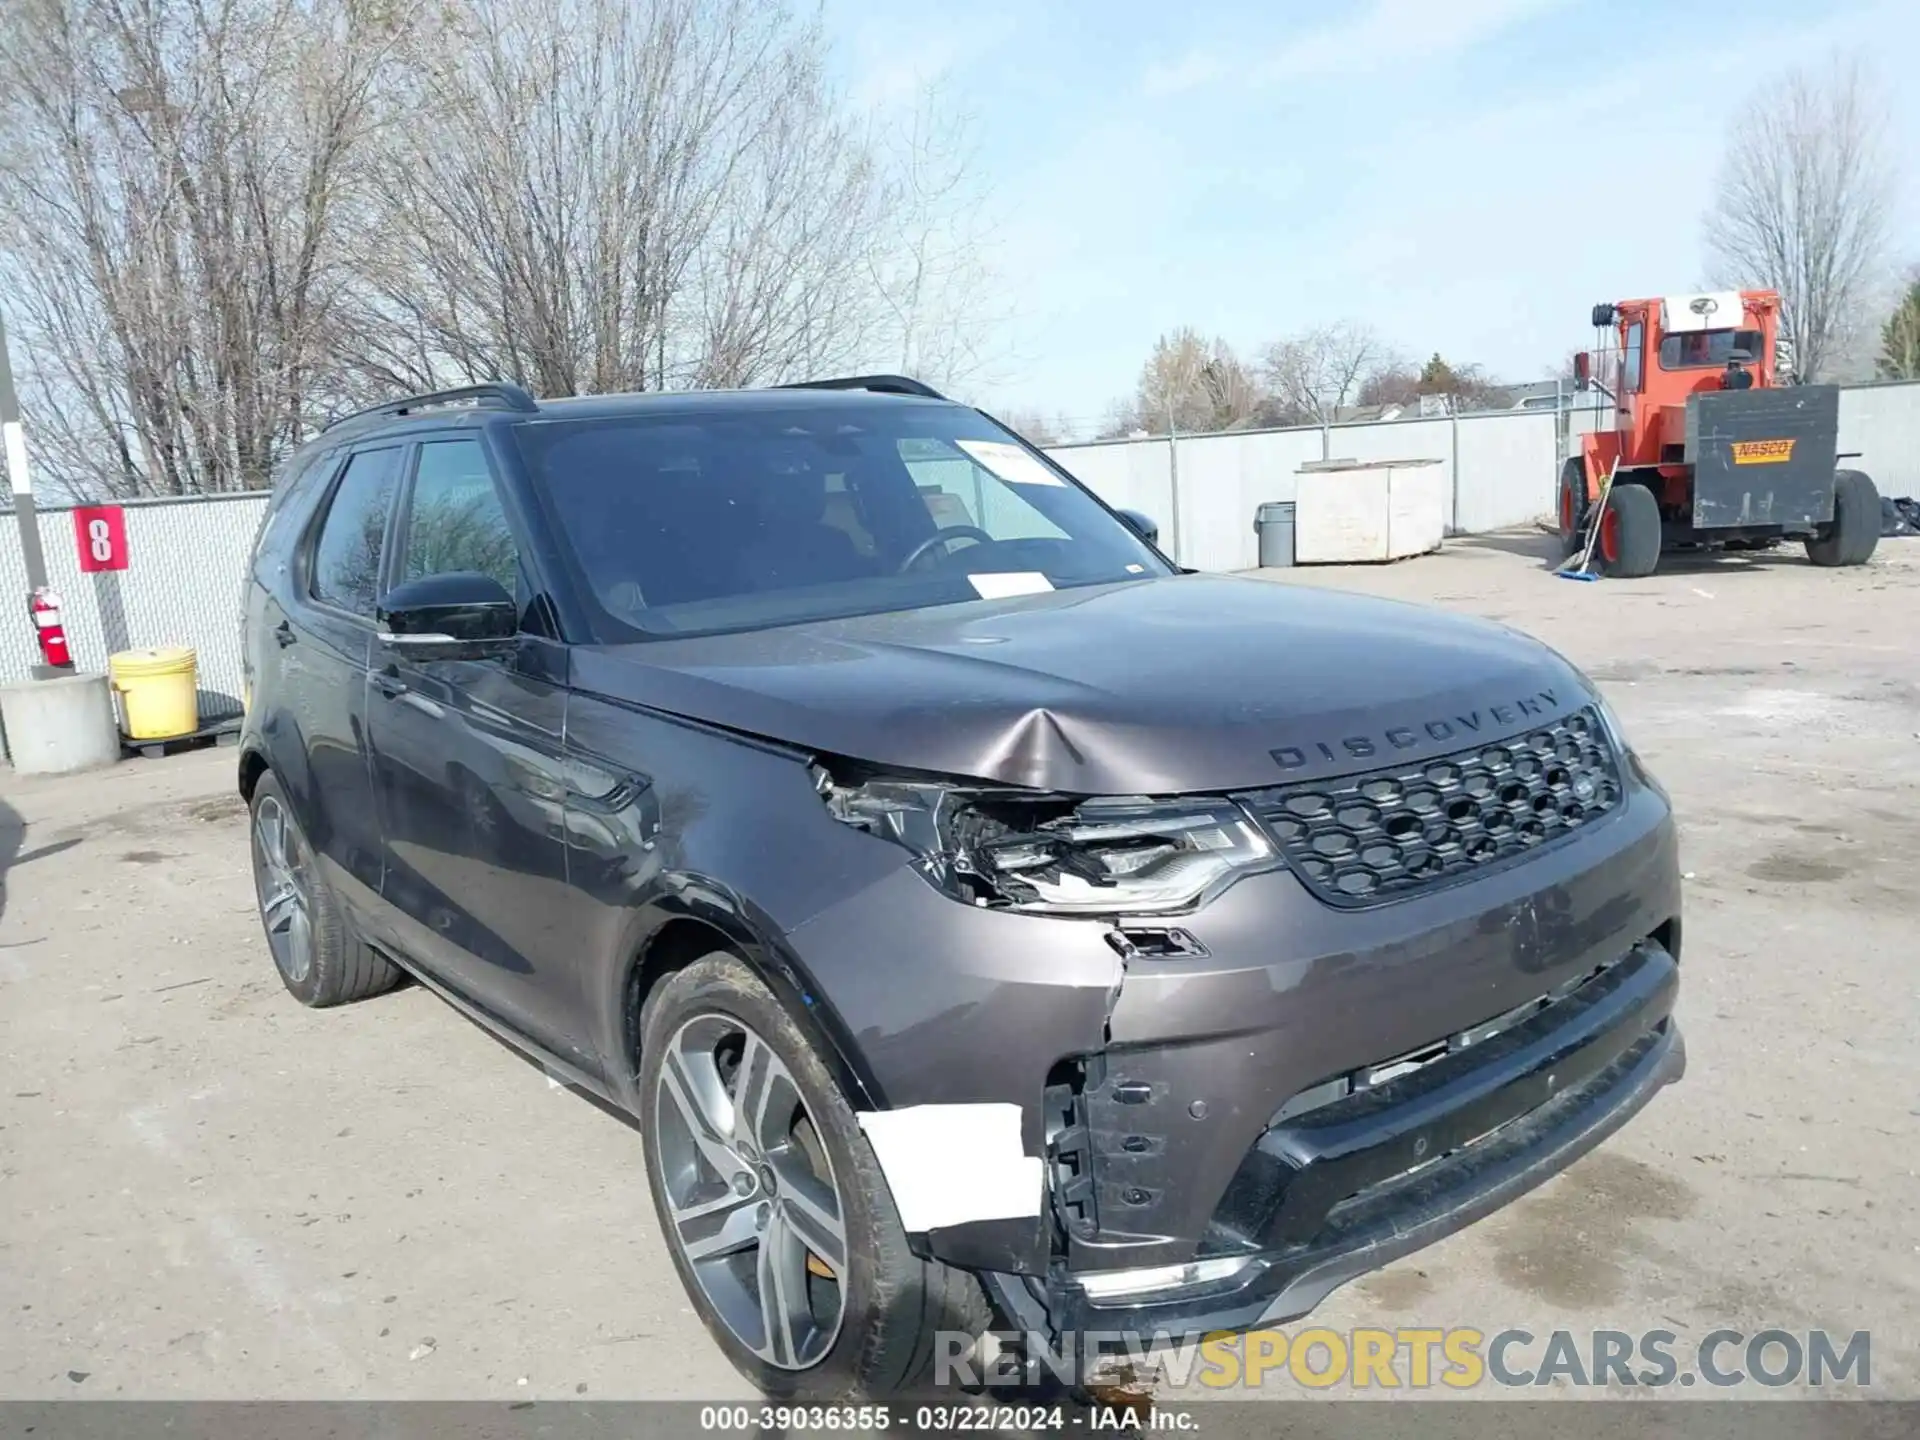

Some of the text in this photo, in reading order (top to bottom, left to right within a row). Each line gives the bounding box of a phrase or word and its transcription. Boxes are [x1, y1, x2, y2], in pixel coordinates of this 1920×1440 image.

[1738, 442, 1789, 456] NASCO
[89, 519, 112, 562] 8
[1268, 689, 1559, 769] DISCOVERY
